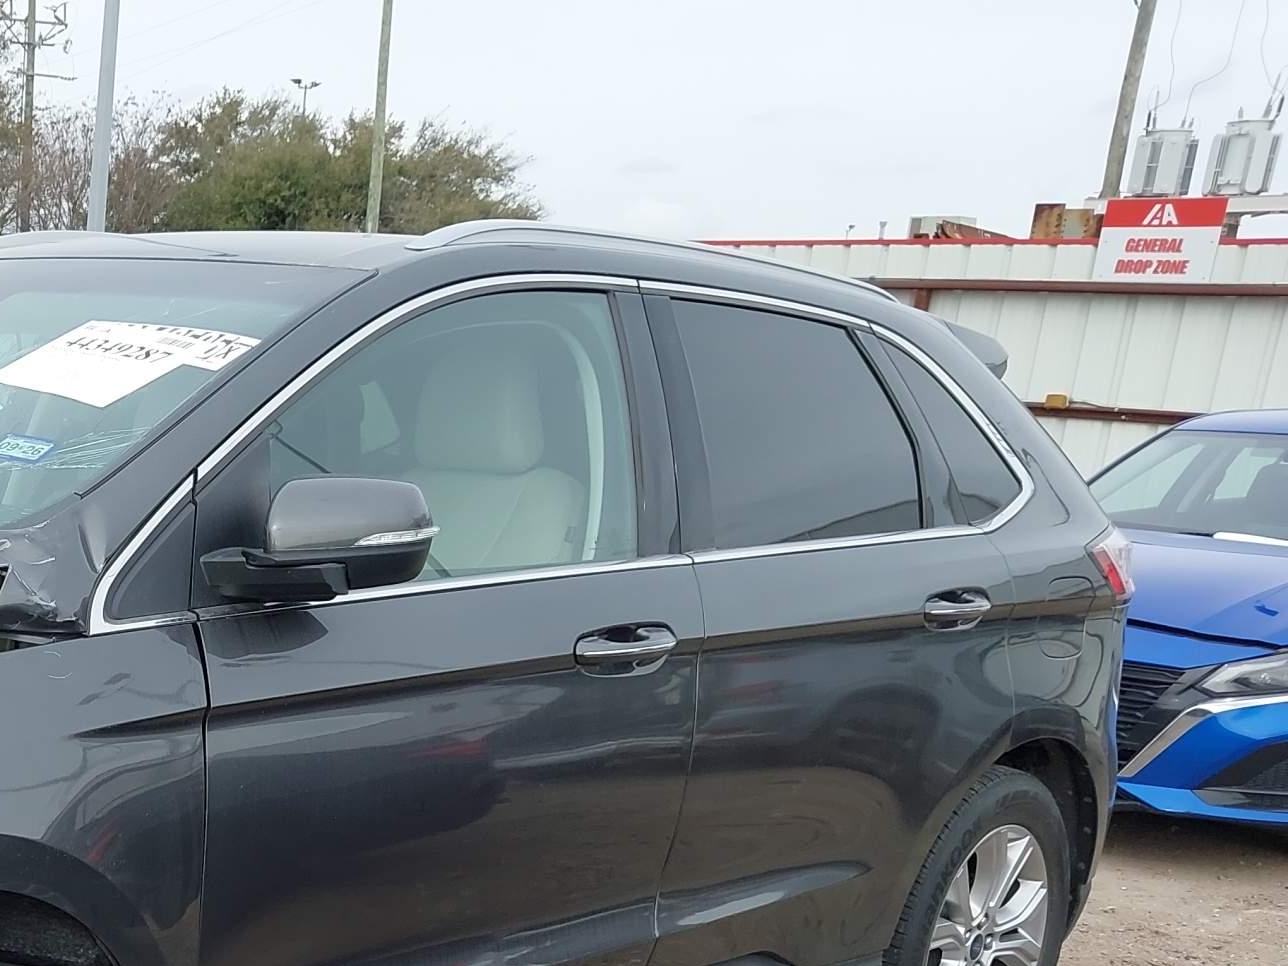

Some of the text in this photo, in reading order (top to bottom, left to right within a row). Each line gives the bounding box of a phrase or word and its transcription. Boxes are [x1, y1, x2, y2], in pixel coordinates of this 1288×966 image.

[1125, 238, 1184, 253] GENERAL
[1114, 259, 1190, 274] DROP ZONE
[65, 336, 173, 363] 44349287
[21, 445, 45, 456] 26
